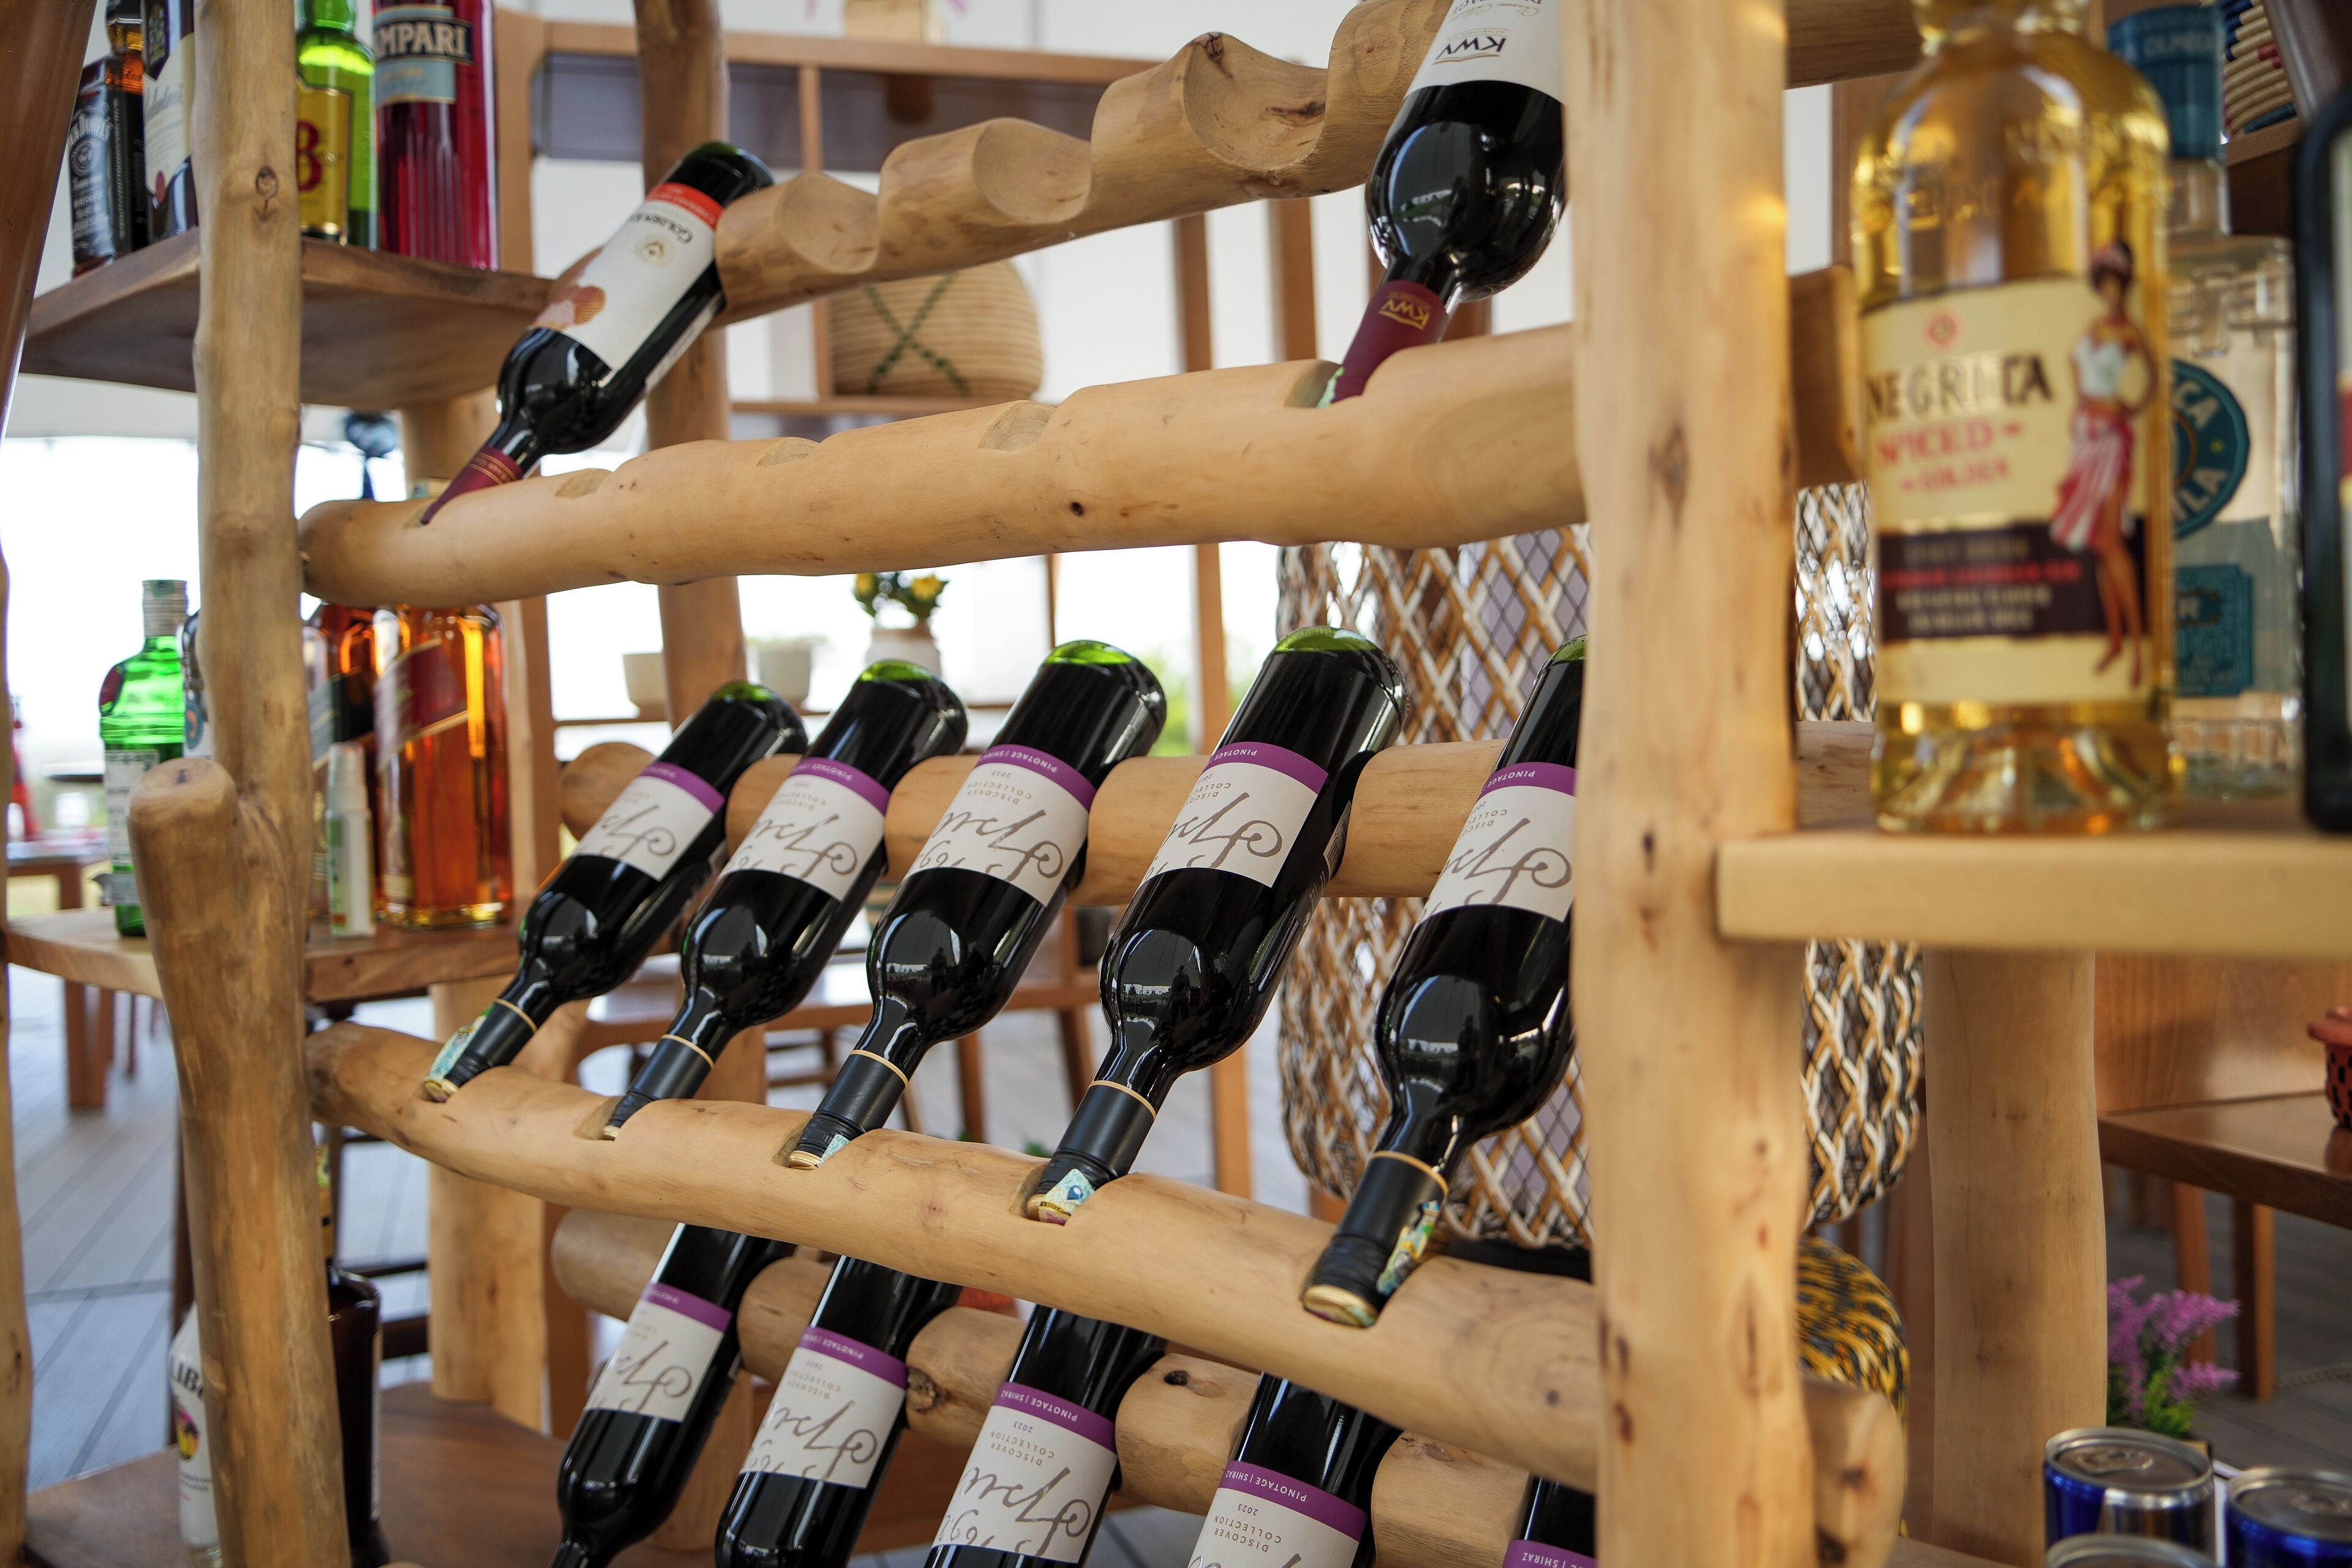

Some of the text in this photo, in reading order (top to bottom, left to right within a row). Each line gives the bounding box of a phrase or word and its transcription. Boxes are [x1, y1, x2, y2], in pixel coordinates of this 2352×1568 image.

[1435, 36, 1507, 61] KWV
[1380, 298, 1430, 326] KWV
[1009, 750, 1058, 772] PINOTAGE
[1213, 749, 1257, 761] PINOTAGE
[811, 763, 853, 782] PINOTAGE
[1487, 771, 1536, 790] PINOTAGE
[822, 1337, 865, 1362] PINOTAGE
[1000, 1389, 1078, 1422] PINOTAGE SHIRAZ
[1012, 1420, 1033, 1433] 2023
[989, 1430, 1054, 1459] COLLECTION
[990, 1441, 1042, 1466] DISCOVER
[1225, 1469, 1307, 1502] PINOTAGE SHIRAZ
[1237, 1503, 1259, 1516] 2023
[1213, 1515, 1281, 1544] COLLECTION
[1213, 1527, 1268, 1553] DISCOVER
[1521, 1552, 1559, 1568] SHIRAZ
